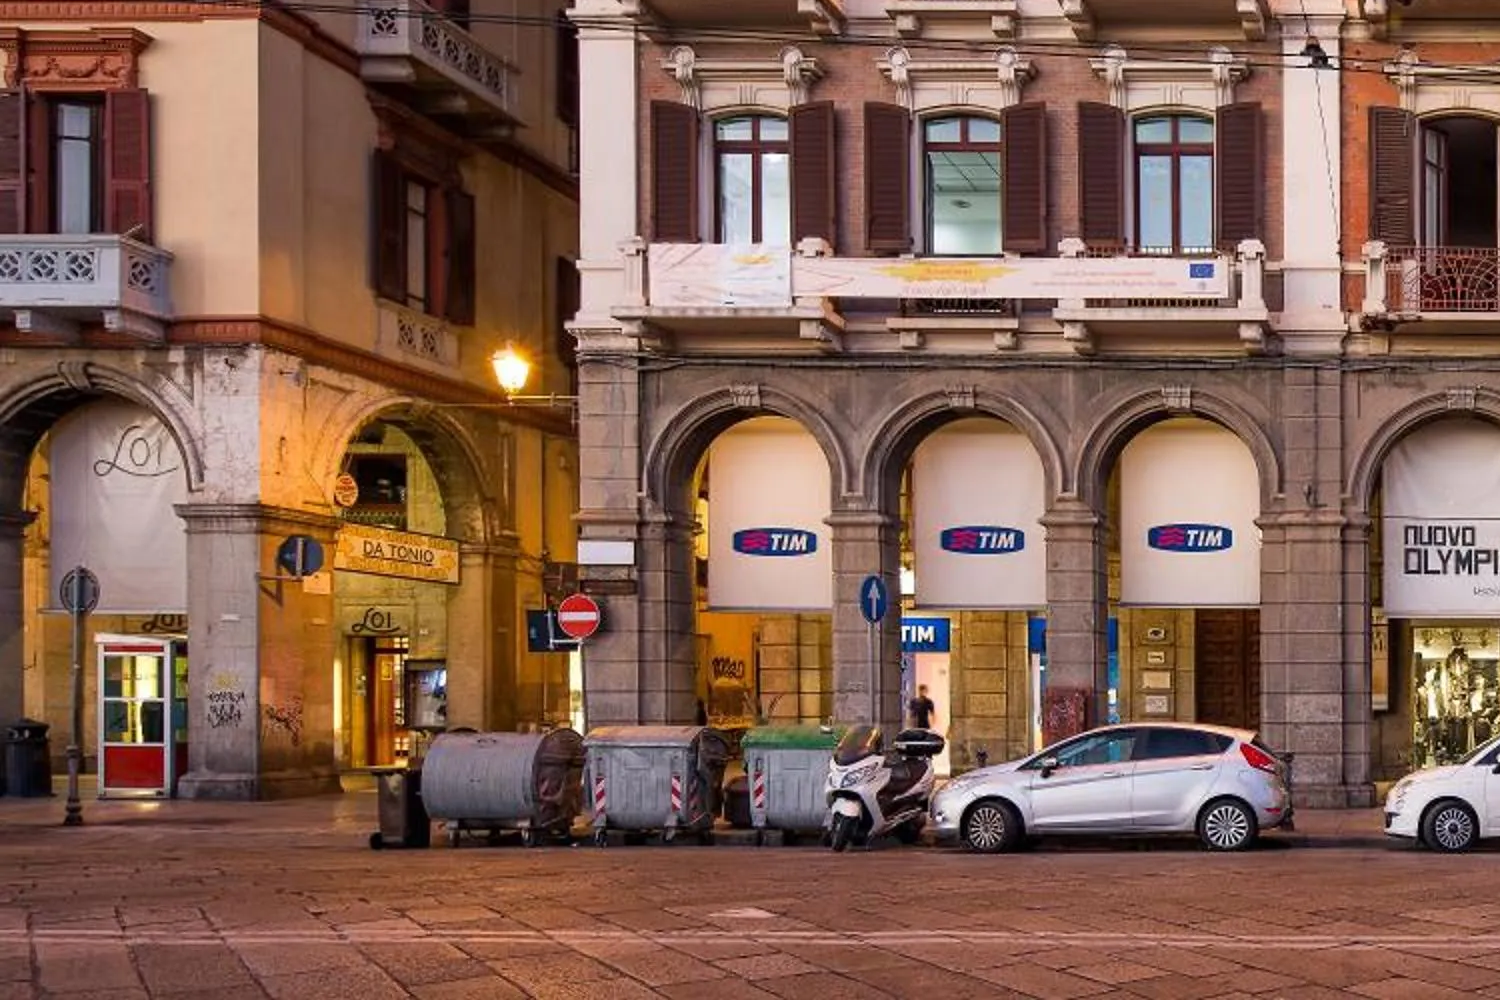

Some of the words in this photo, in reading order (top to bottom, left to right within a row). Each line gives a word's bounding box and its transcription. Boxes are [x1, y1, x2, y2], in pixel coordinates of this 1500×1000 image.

[771, 533, 808, 551] TIM
[979, 531, 1015, 549] TIM
[1187, 529, 1223, 547] TIM
[363, 539, 383, 556] DA
[388, 543, 434, 563] TONIO
[901, 625, 935, 643] TIM
